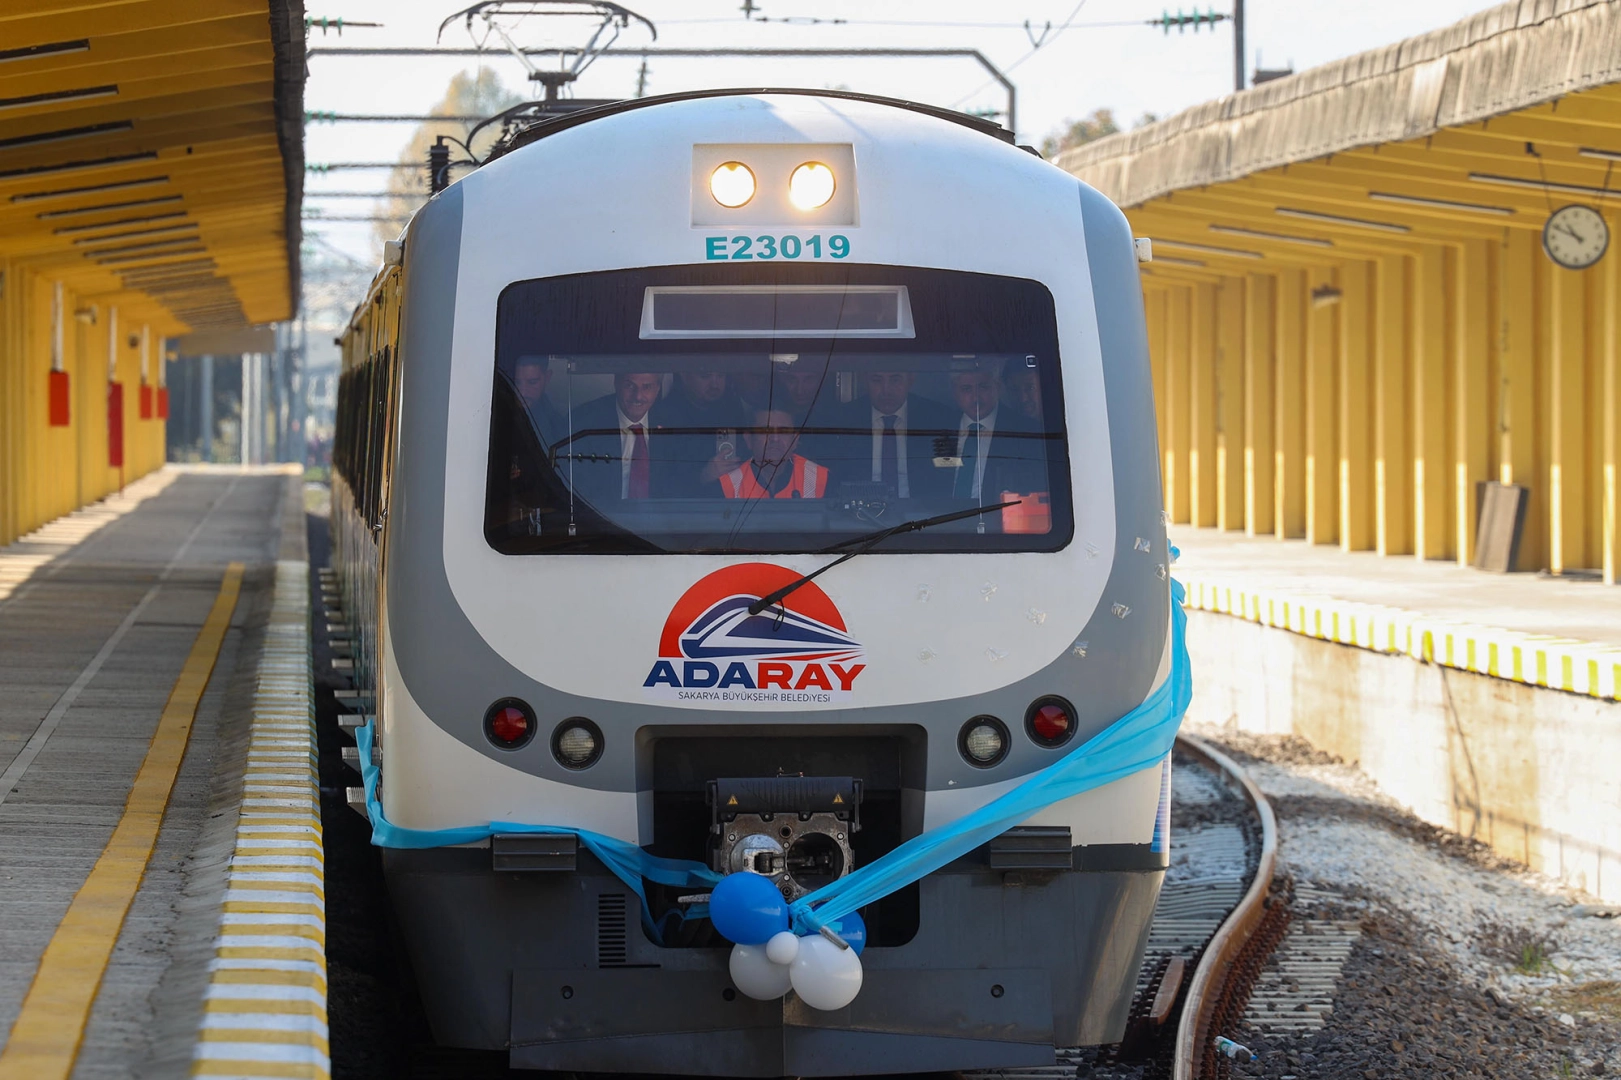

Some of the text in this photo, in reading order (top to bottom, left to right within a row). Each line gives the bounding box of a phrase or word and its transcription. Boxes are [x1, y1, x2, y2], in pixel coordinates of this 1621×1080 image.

[706, 235, 850, 260] E23019
[643, 660, 866, 691] ADARAY
[678, 691, 720, 701] SAKARYA
